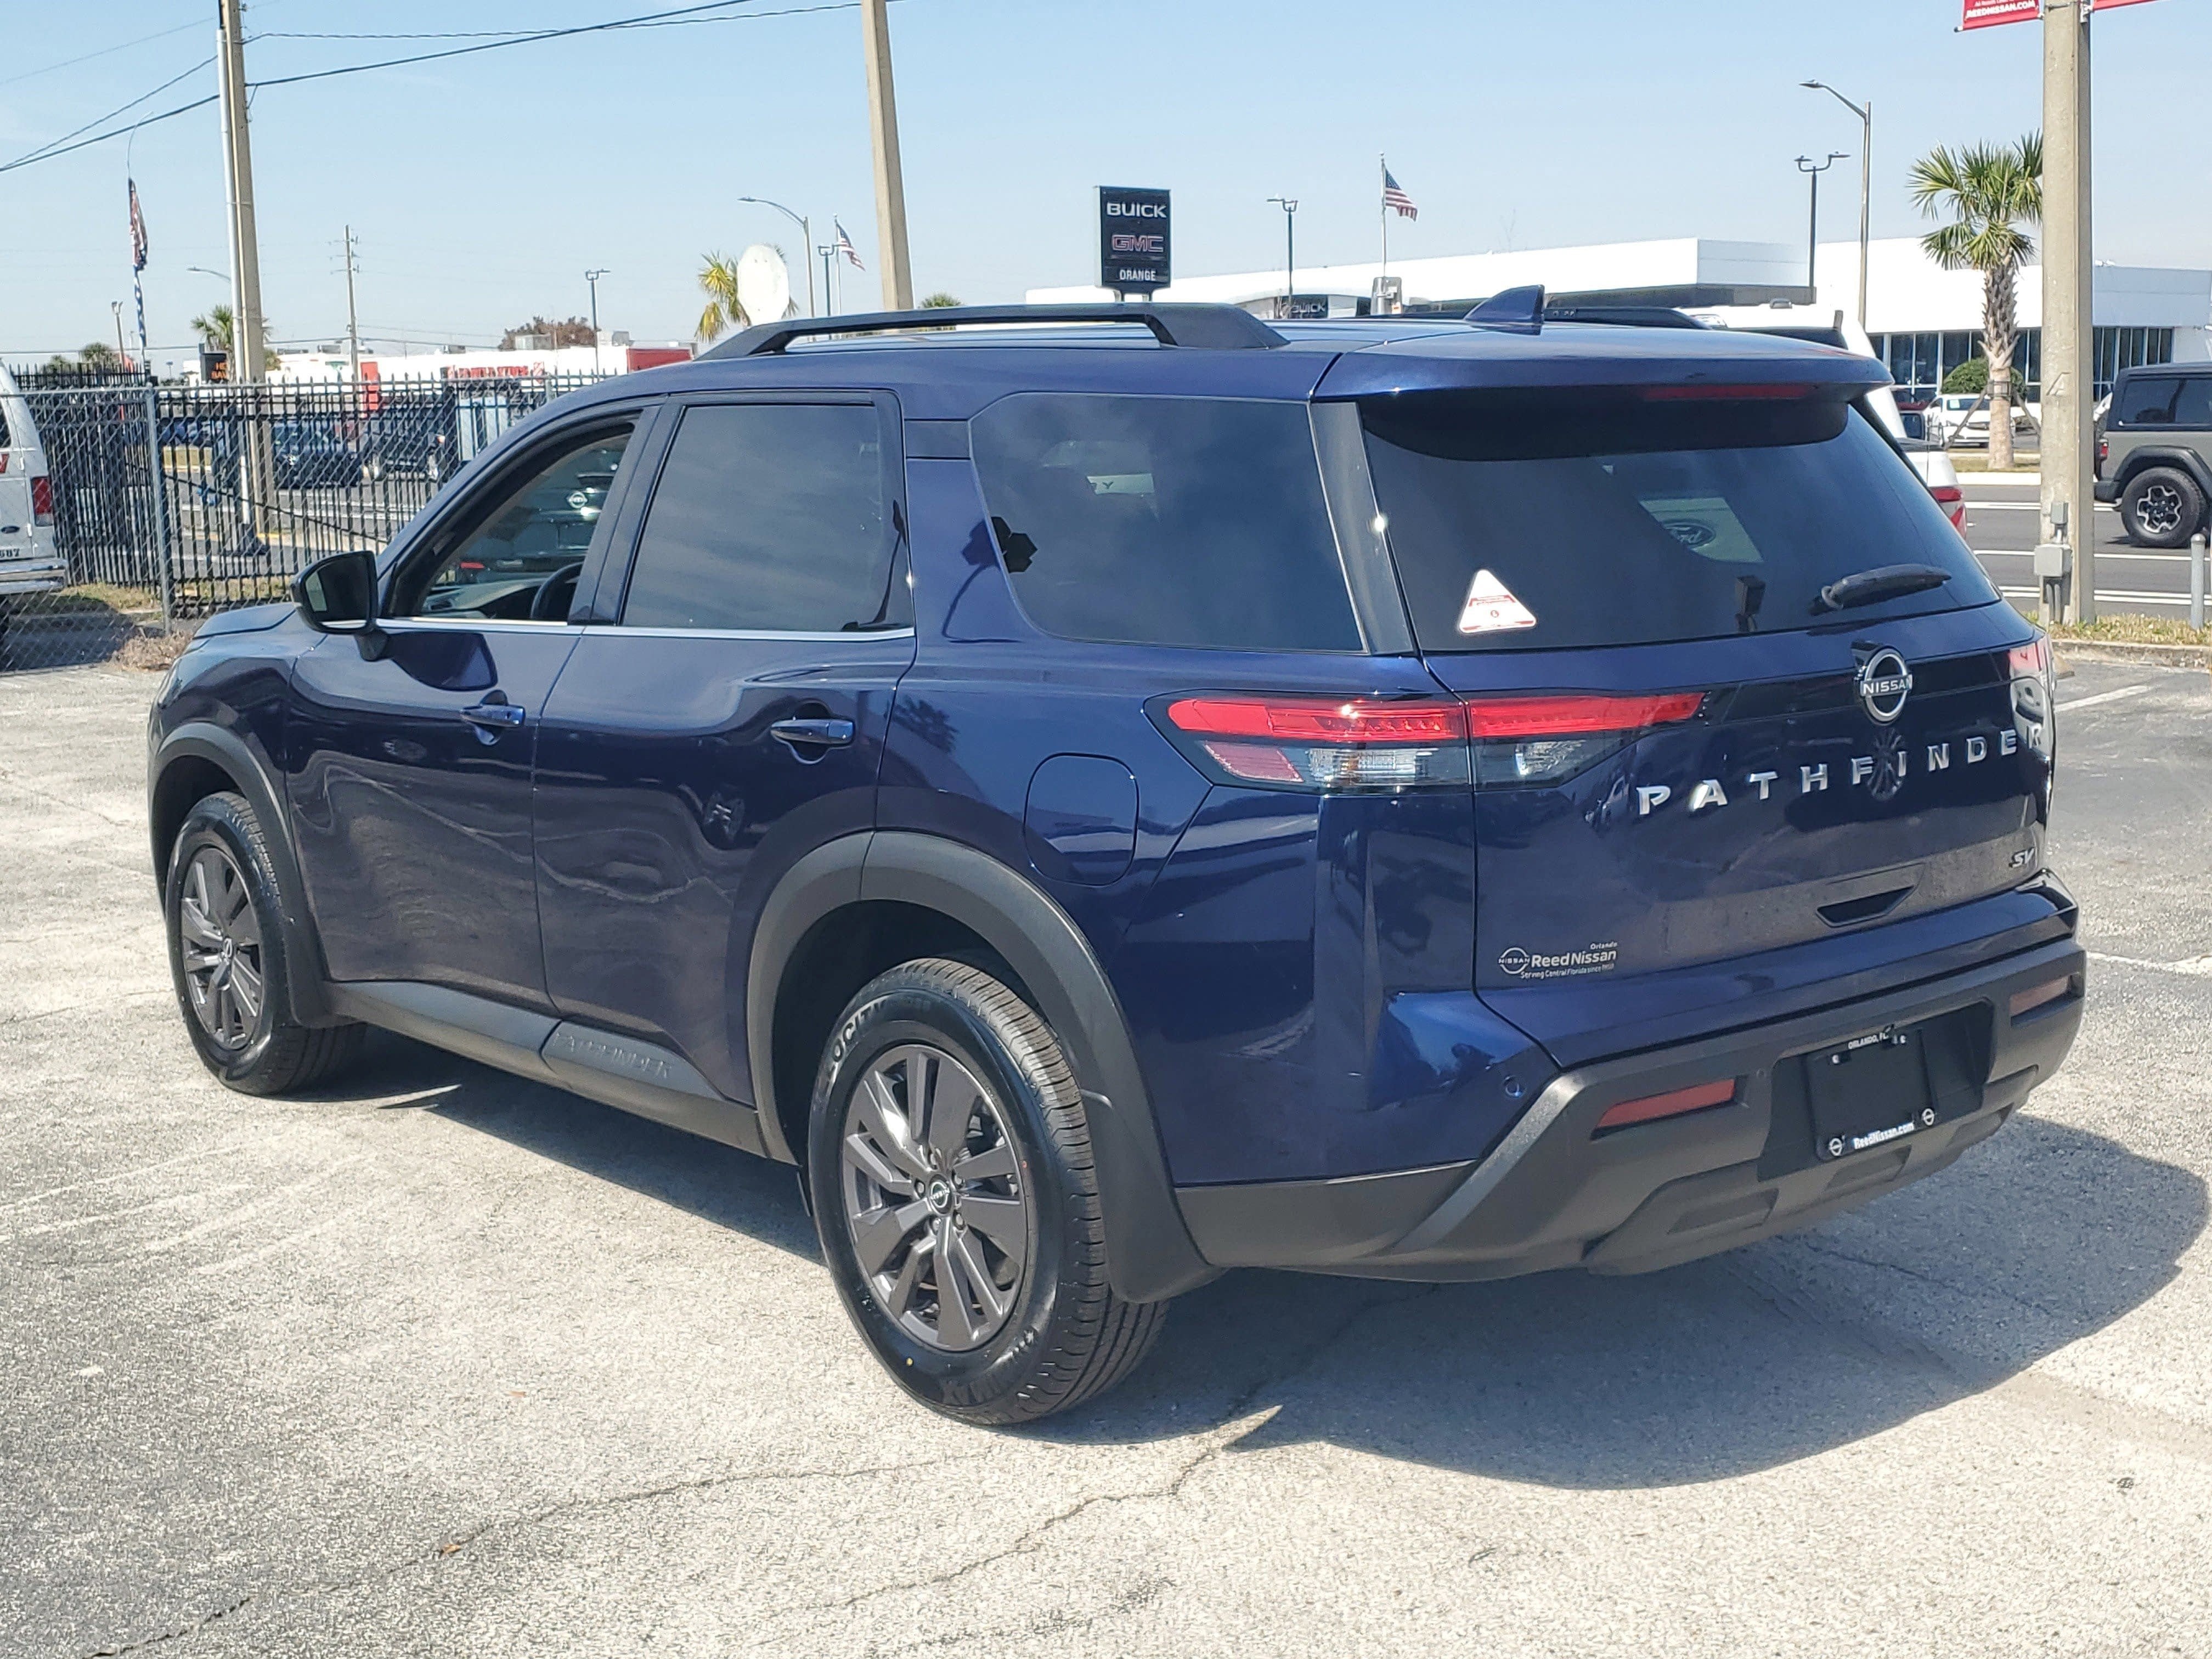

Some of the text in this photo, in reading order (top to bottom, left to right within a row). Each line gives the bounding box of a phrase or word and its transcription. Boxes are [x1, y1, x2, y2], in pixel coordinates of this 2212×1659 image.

[1107, 202, 1167, 218] BUICK
[1111, 234, 1164, 252] GMC
[1119, 269, 1156, 281] ORANGE
[1863, 675, 1912, 695] NISSAN
[1637, 723, 2042, 815] PATHFINDER
[2012, 848, 2035, 867] SV
[1590, 941, 1618, 950] Orlando
[1521, 971, 1544, 979] Serving
[1545, 969, 1567, 977] Central
